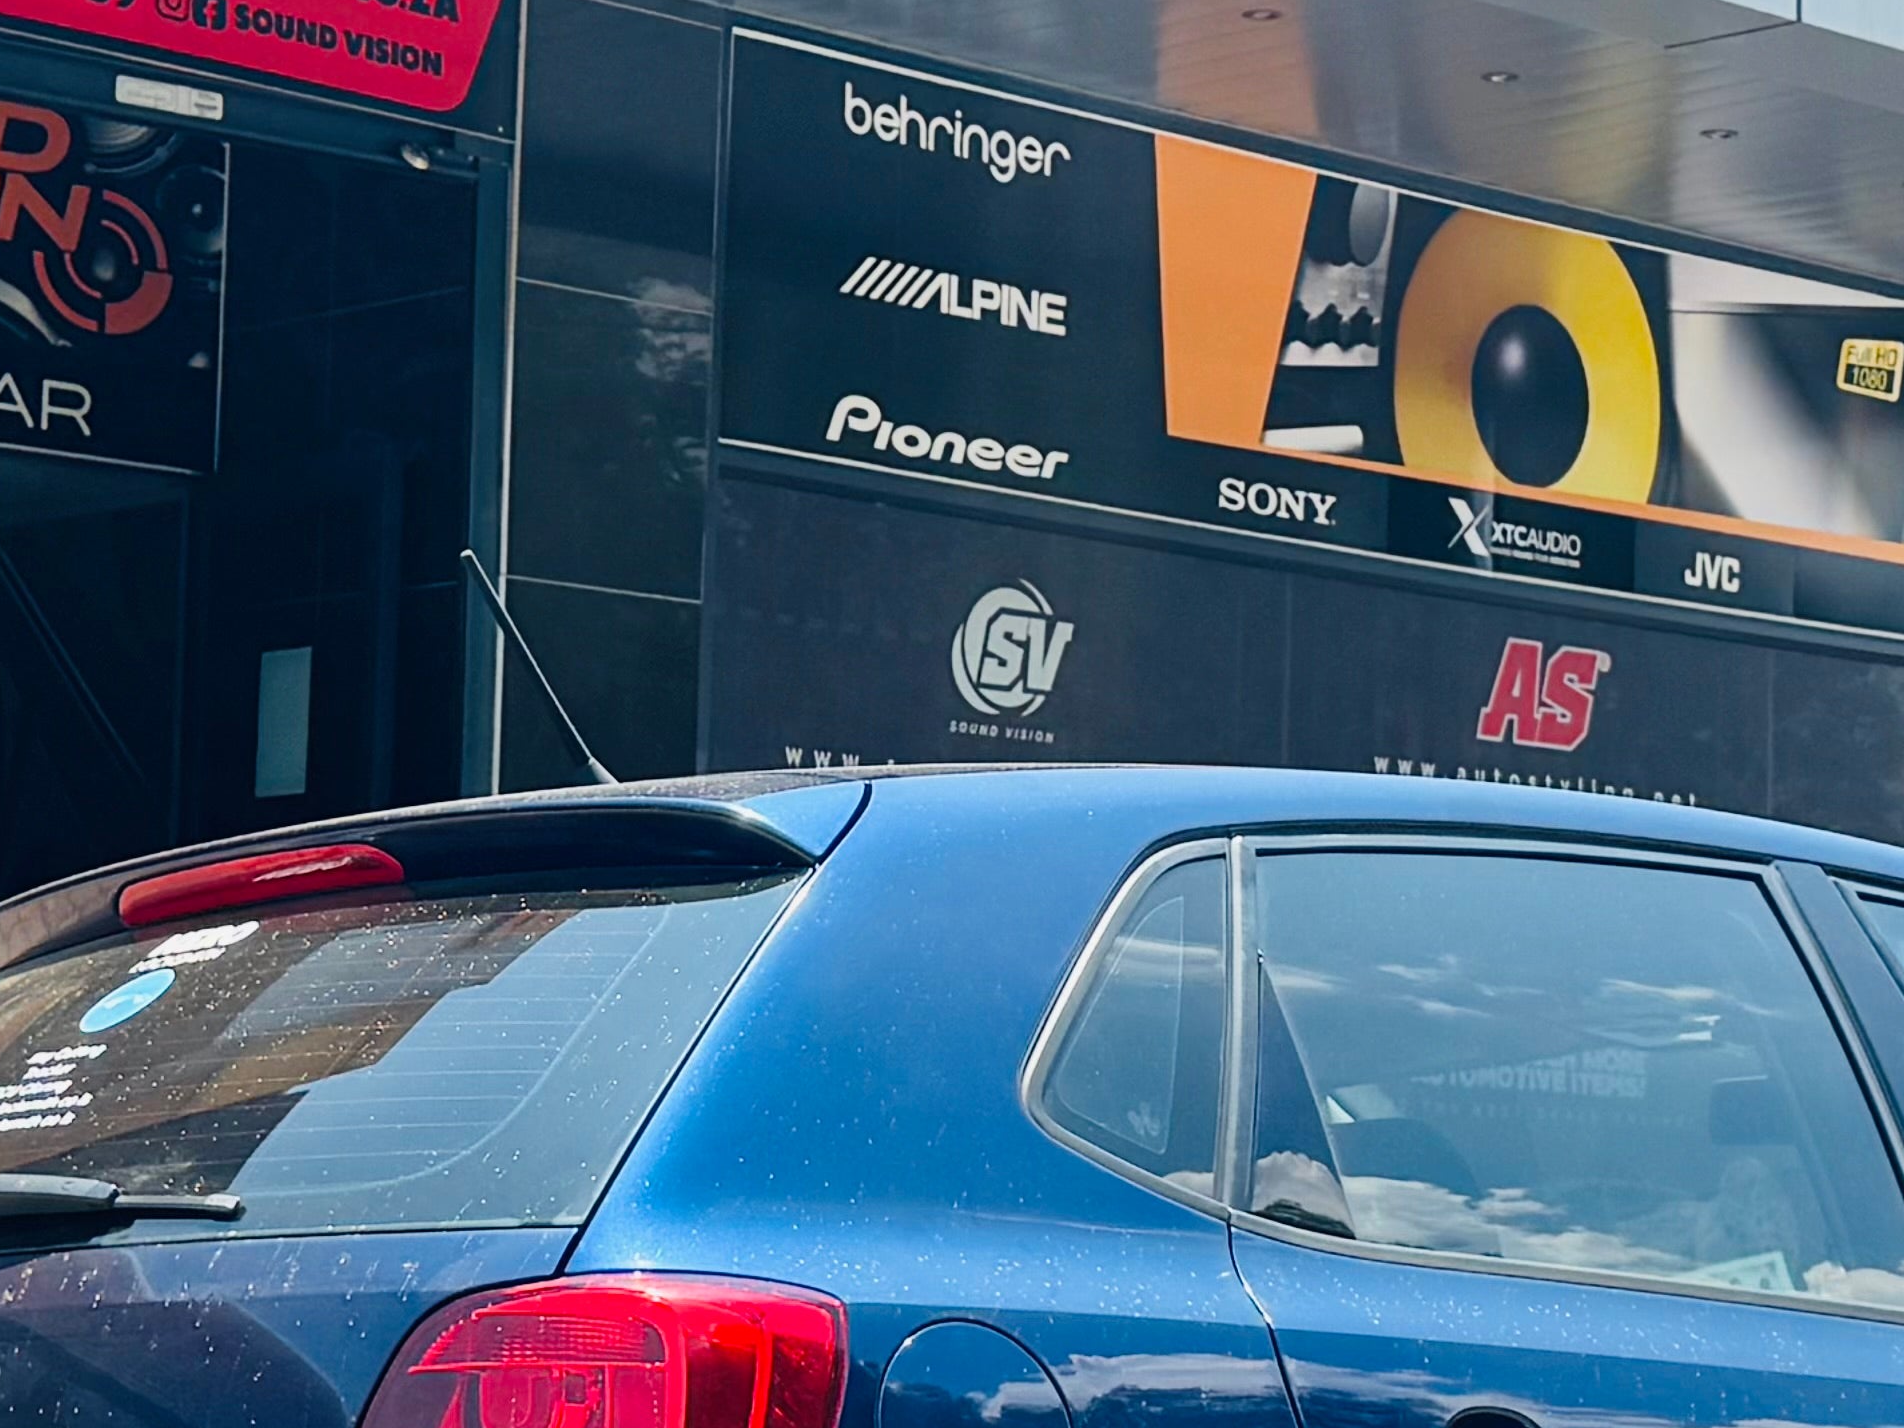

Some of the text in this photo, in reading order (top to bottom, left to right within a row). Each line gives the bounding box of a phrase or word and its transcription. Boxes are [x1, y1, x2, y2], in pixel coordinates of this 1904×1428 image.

[235, 3, 444, 77] SOUND VISION
[844, 81, 1071, 183] behringer
[840, 256, 1067, 337] ALPINE
[1846, 345, 1898, 369] Full HD
[1852, 367, 1888, 391] 1080
[826, 394, 1070, 479] Pioneer
[1218, 477, 1337, 525] SONY
[1684, 552, 1741, 593] JVC
[1476, 637, 1601, 752] AS
[949, 720, 1055, 744] SOUND VISION
